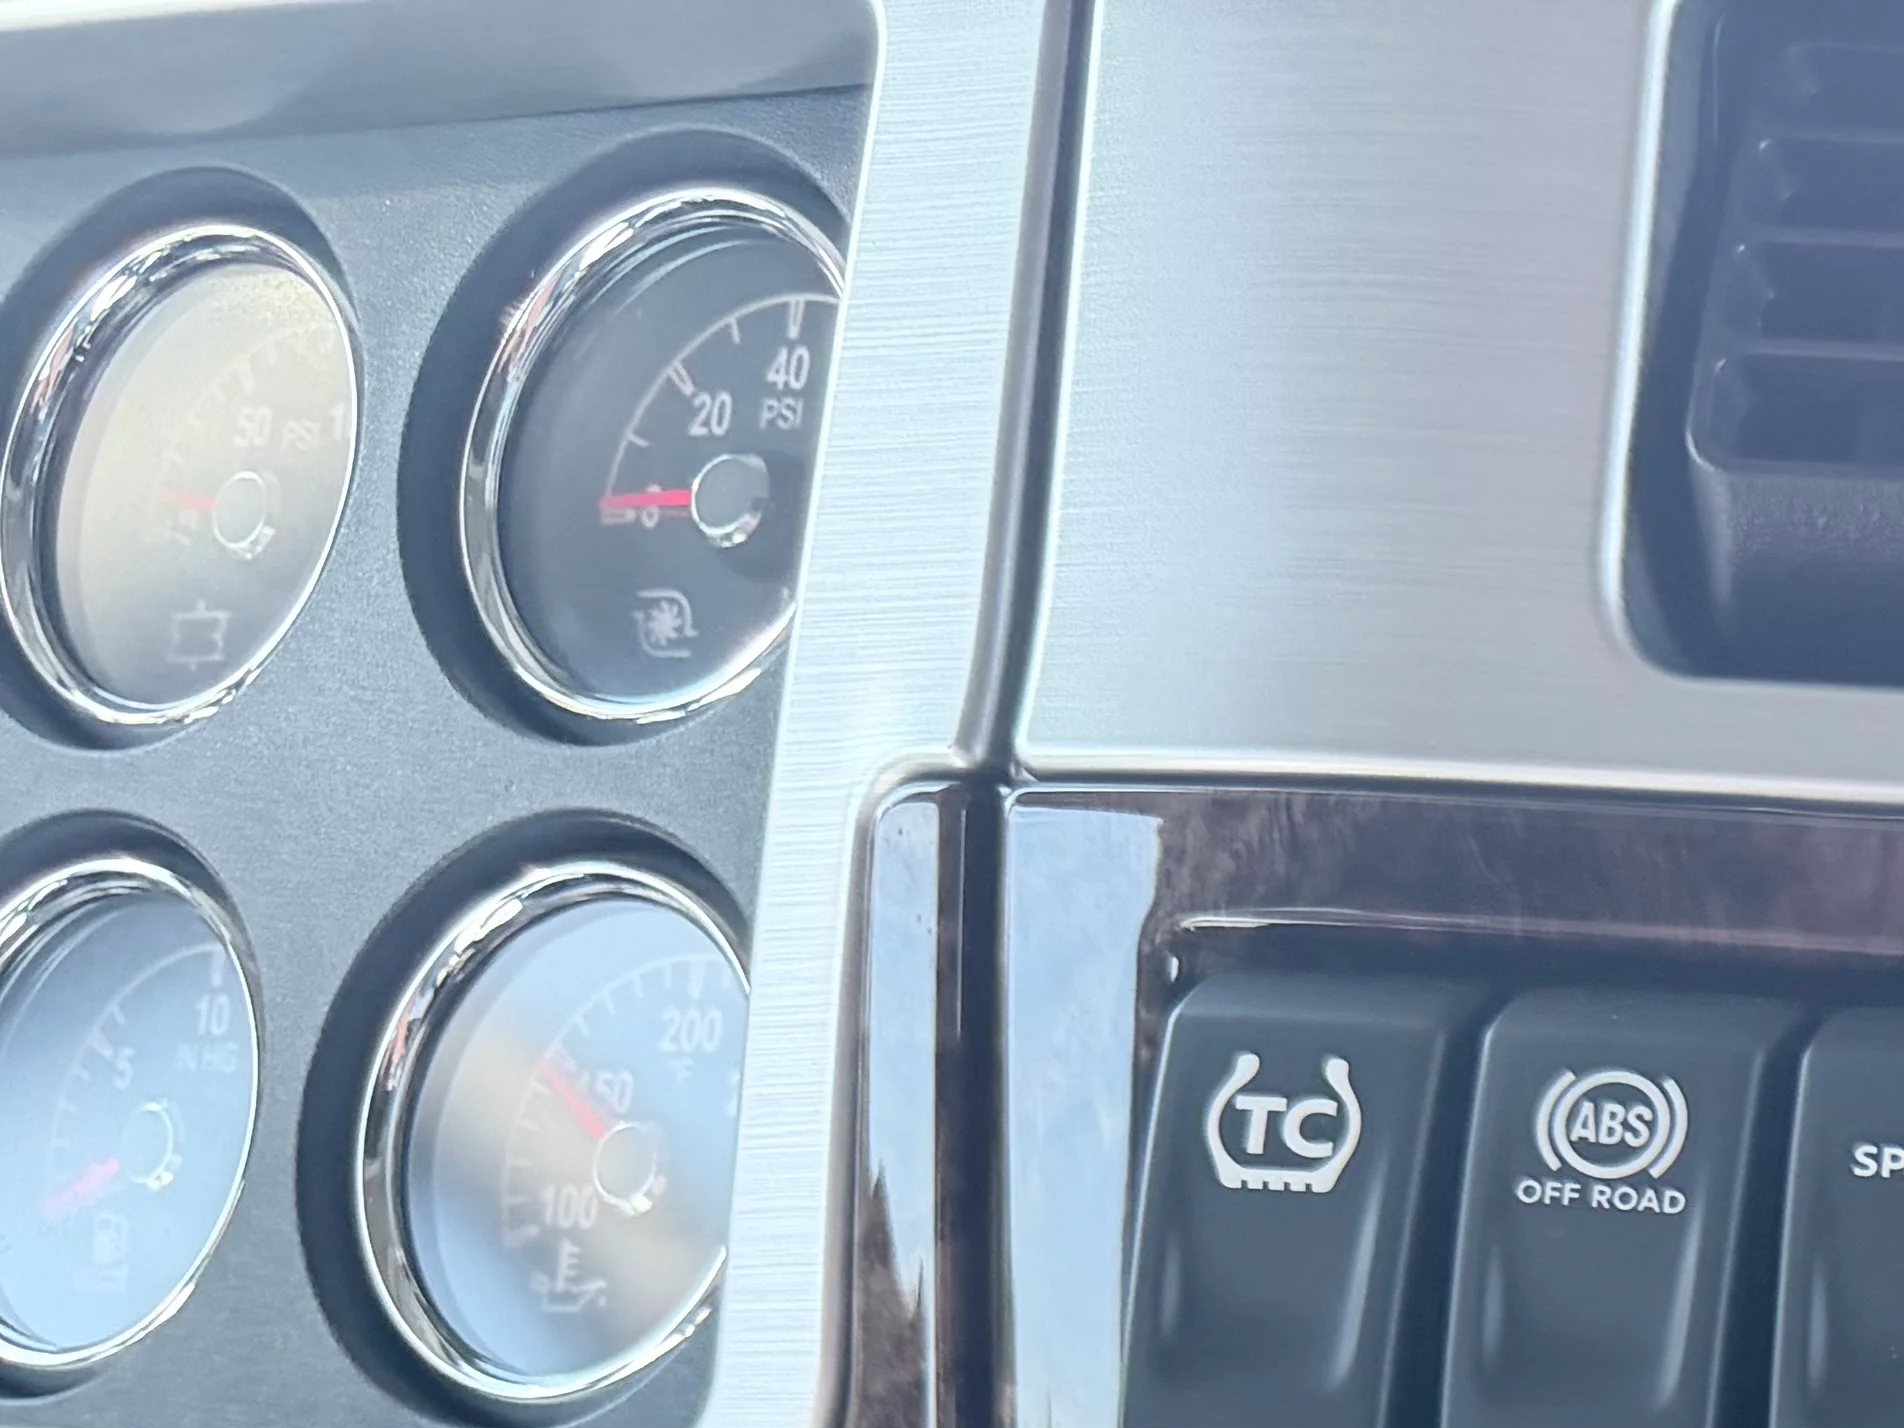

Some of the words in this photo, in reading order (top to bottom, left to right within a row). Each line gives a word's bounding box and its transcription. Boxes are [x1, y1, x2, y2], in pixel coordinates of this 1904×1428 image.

[765, 344, 811, 391] 40
[687, 389, 734, 437] 20
[758, 396, 804, 430] PSI
[195, 992, 231, 1036] 10
[656, 1005, 723, 1053] 200
[1234, 1094, 1338, 1159] TC
[1569, 1100, 1653, 1148] ABS
[540, 1184, 599, 1231] 100
[1515, 1177, 1581, 1207] OFF
[1591, 1184, 1687, 1215] ROAD
